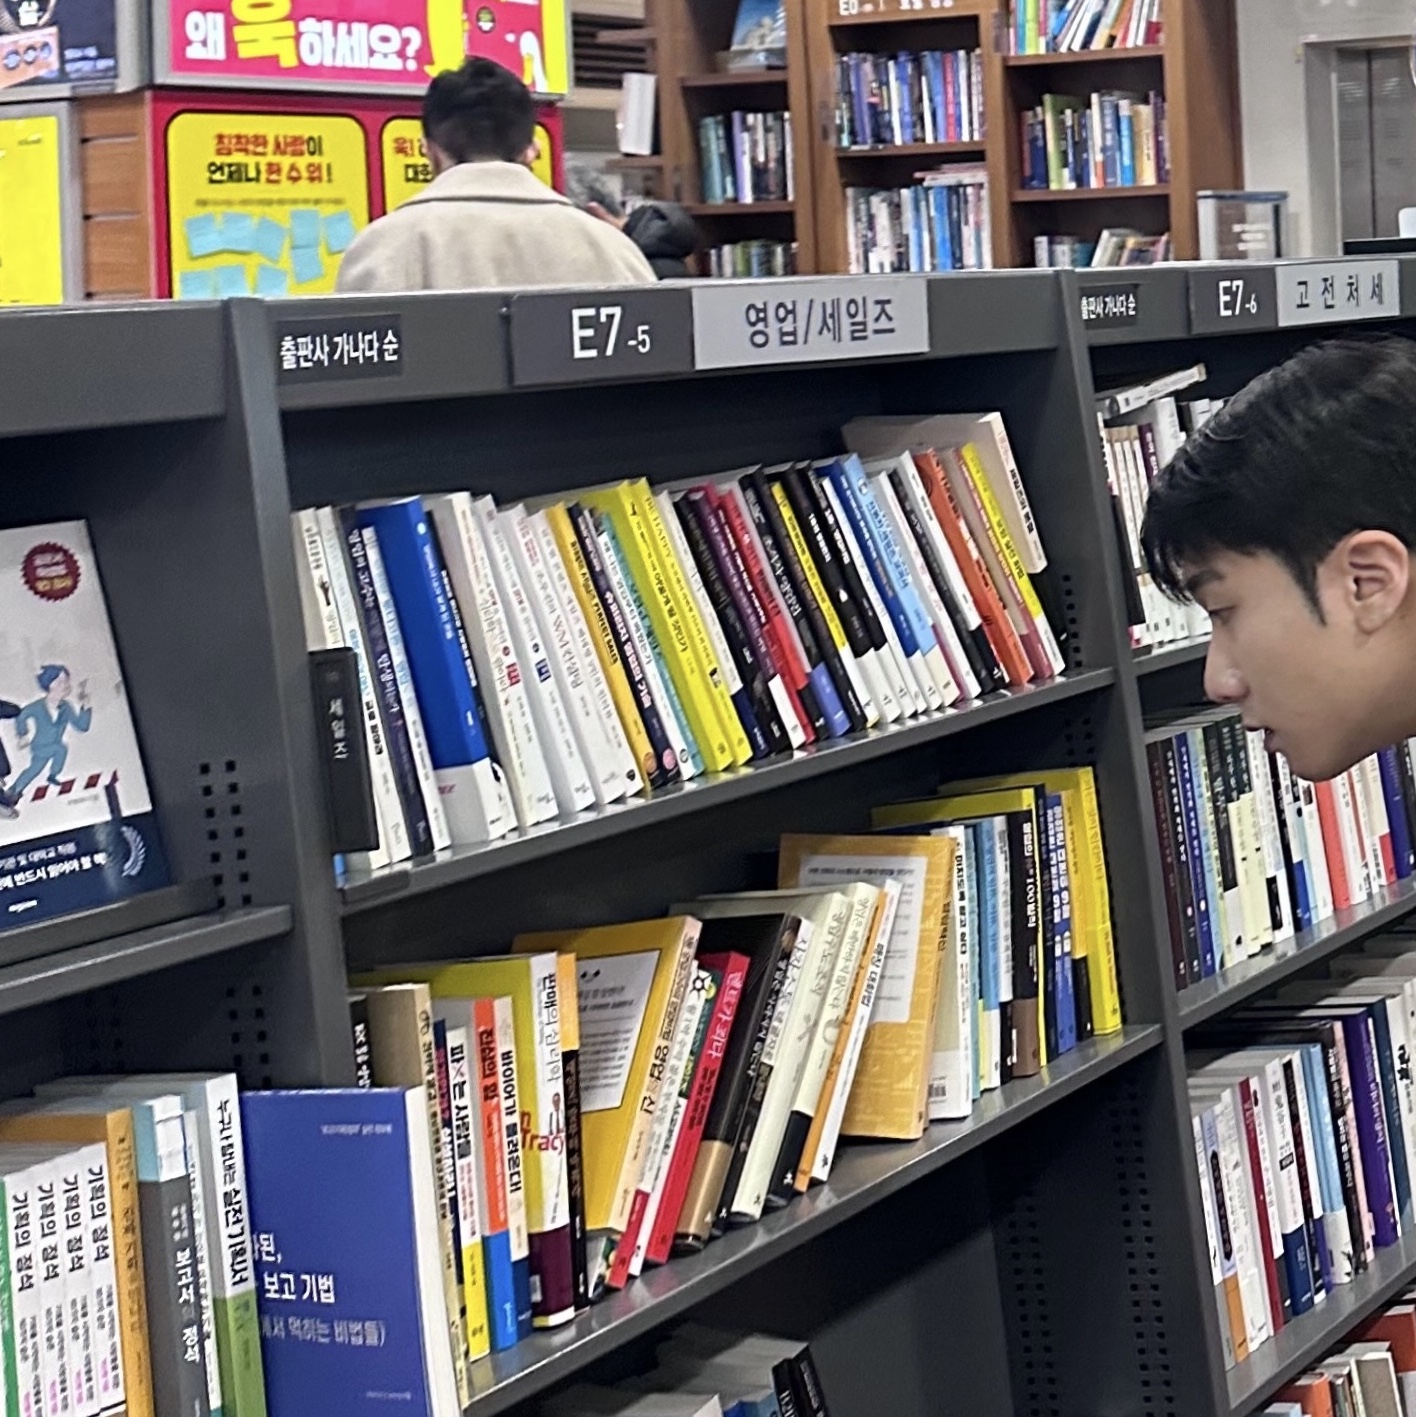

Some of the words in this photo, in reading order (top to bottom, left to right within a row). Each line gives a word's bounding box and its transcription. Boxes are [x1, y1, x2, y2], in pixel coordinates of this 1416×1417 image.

[185, 11, 226, 60] 왜
[273, 135, 323, 156] 사람이
[207, 162, 261, 184] 언제나
[745, 297, 896, 348] 영업/세일즈
[1081, 293, 1104, 320] 출판사
[1104, 293, 1127, 317] 가나다
[1127, 292, 1137, 316] 순
[280, 333, 330, 371] 출판사
[333, 331, 379, 365] 가나다
[382, 328, 400, 361] 순
[499, 1050, 517, 1115] 바이어가
[215, 1099, 232, 1142] 누구나
[37, 1182, 57, 1238] 기획의
[61, 1174, 81, 1230] 기획의
[86, 1164, 106, 1219] 기획의
[222, 1188, 244, 1227] 실전
[11, 1192, 31, 1248] 기획의
[91, 1222, 110, 1261] 정석
[15, 1251, 34, 1292] 정석
[41, 1243, 59, 1281] 정석
[65, 1233, 84, 1272] 정석
[225, 1227, 249, 1287] 기획서
[263, 1272, 296, 1301] 보고
[300, 1274, 336, 1304] 기법
